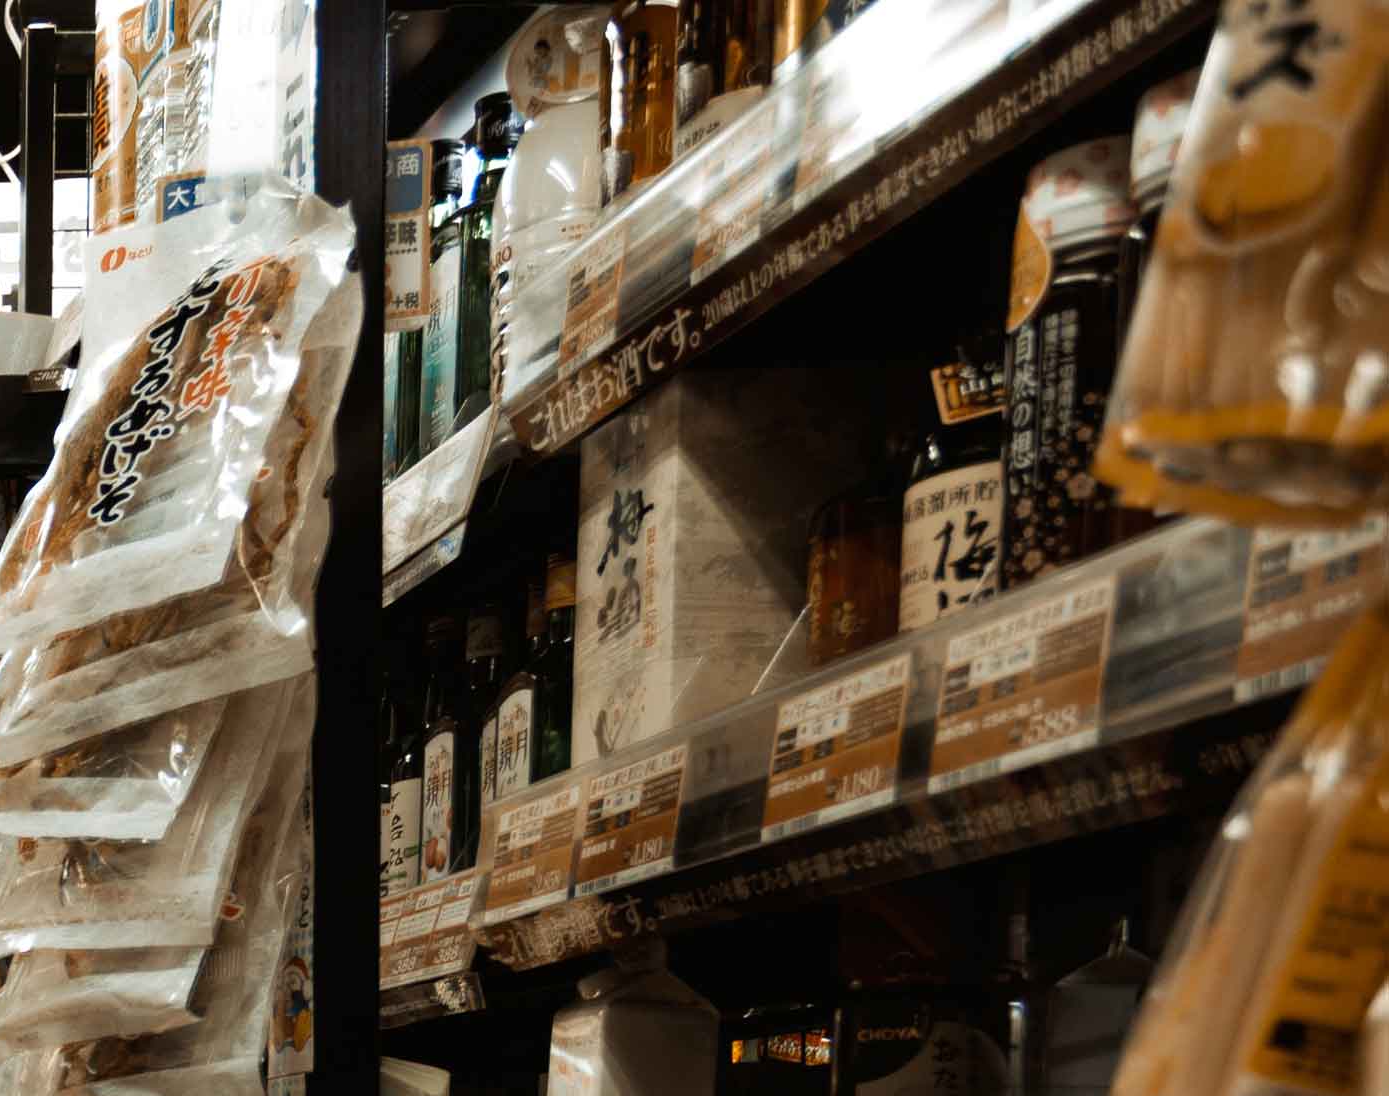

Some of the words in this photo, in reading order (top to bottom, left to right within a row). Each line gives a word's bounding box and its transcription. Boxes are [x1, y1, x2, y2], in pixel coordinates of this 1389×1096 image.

[529, 306, 702, 451] これはお酒です。
